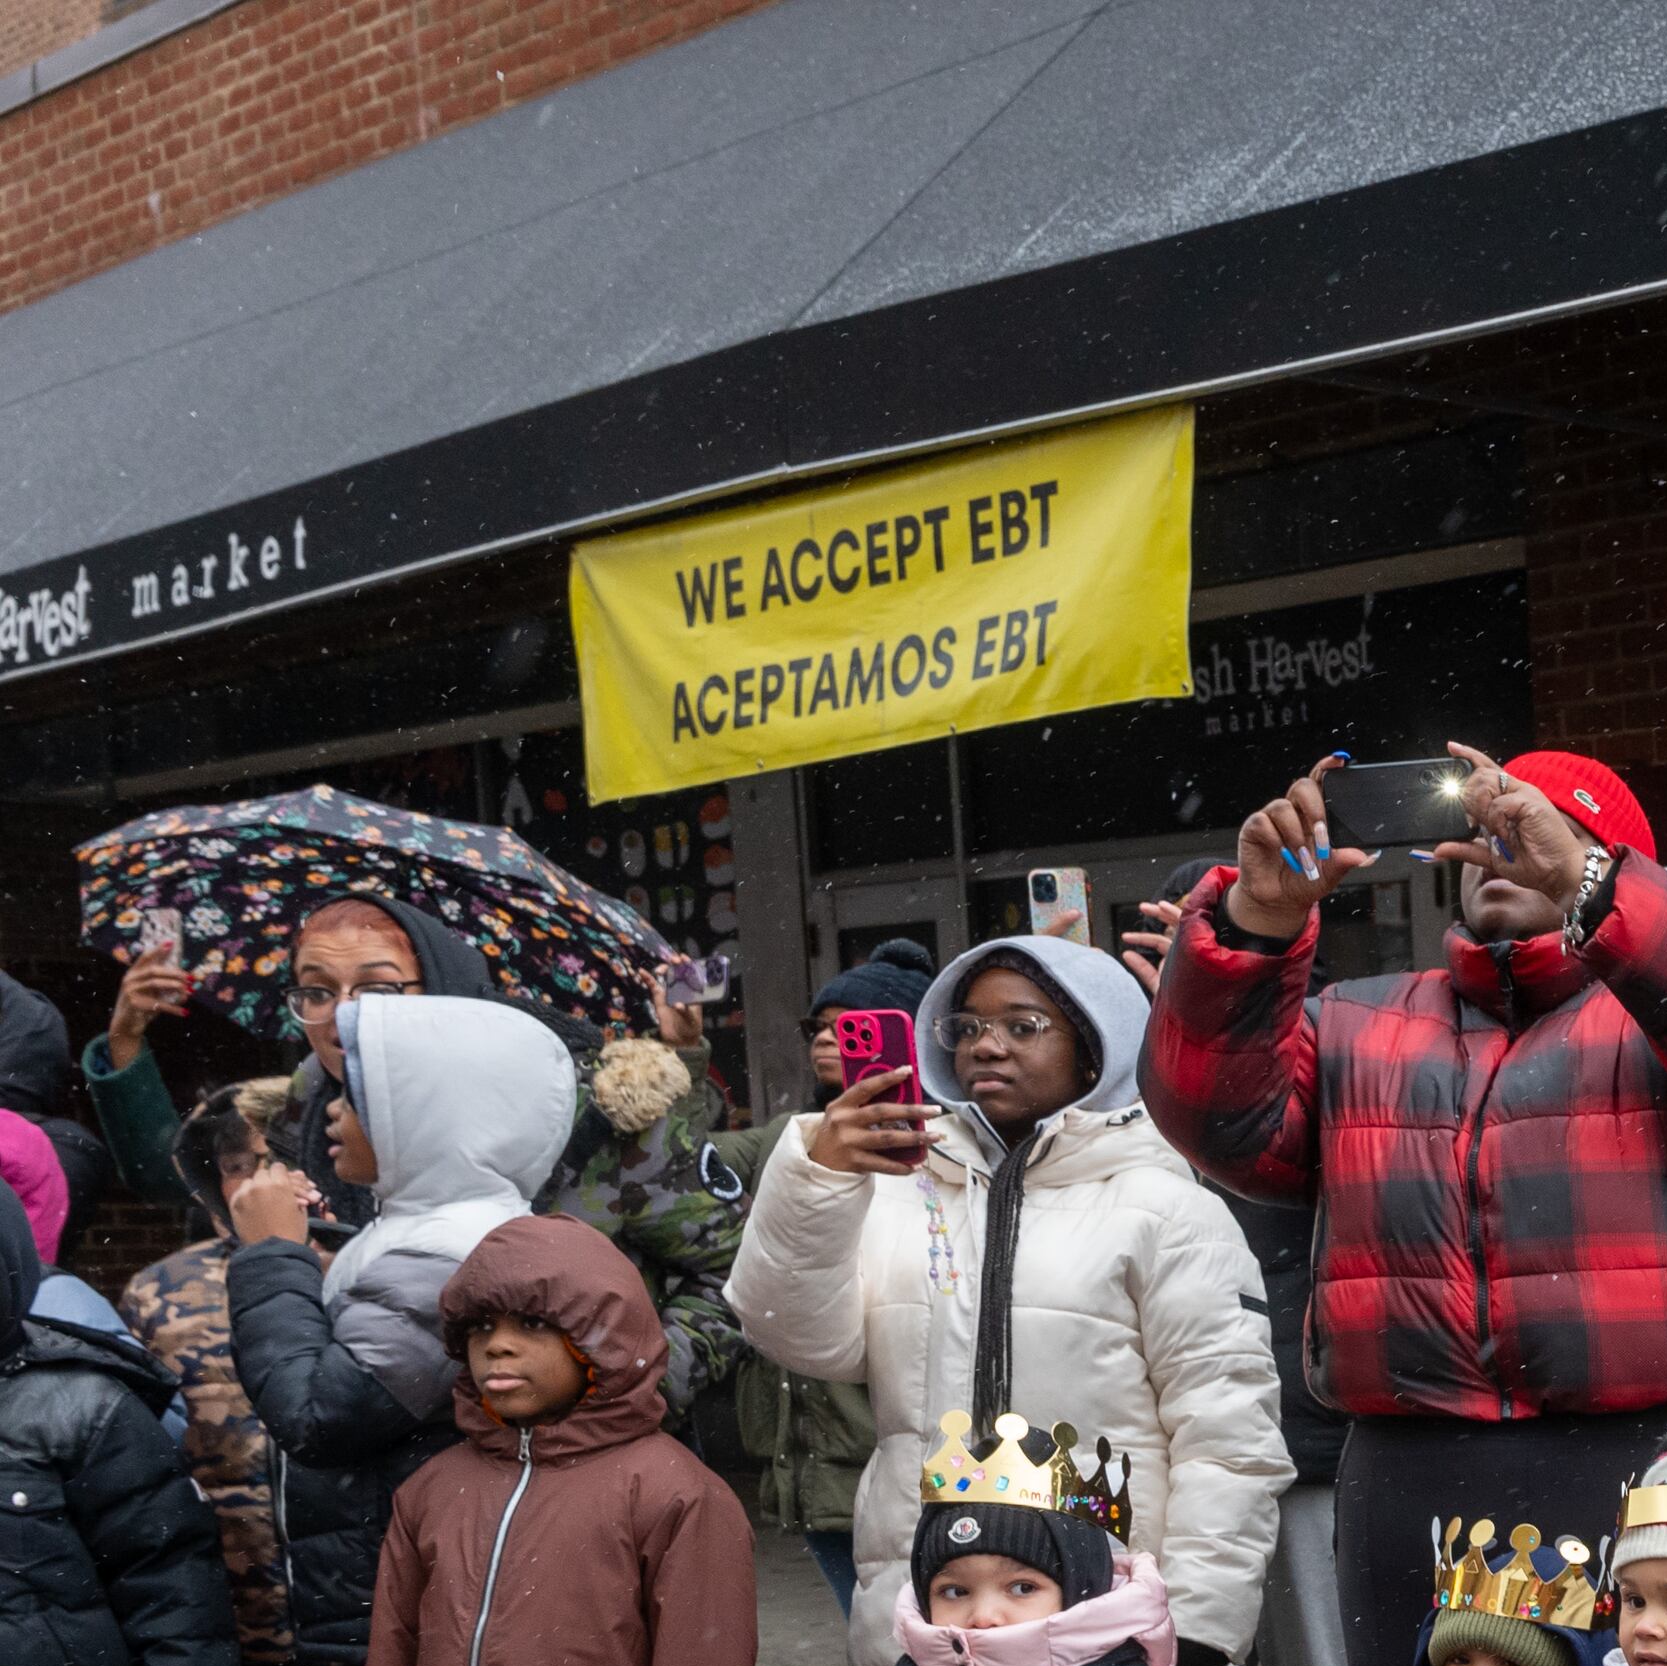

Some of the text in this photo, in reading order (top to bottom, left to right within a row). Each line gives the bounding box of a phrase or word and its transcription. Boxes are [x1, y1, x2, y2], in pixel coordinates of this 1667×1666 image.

[0, 515, 308, 664] arvest market
[676, 480, 1059, 627] WE ACCEPT EBT
[672, 600, 1059, 743] ACEPTAMOS EBT
[1205, 701, 1309, 736] market
[1247, 624, 1374, 695] Harvest
